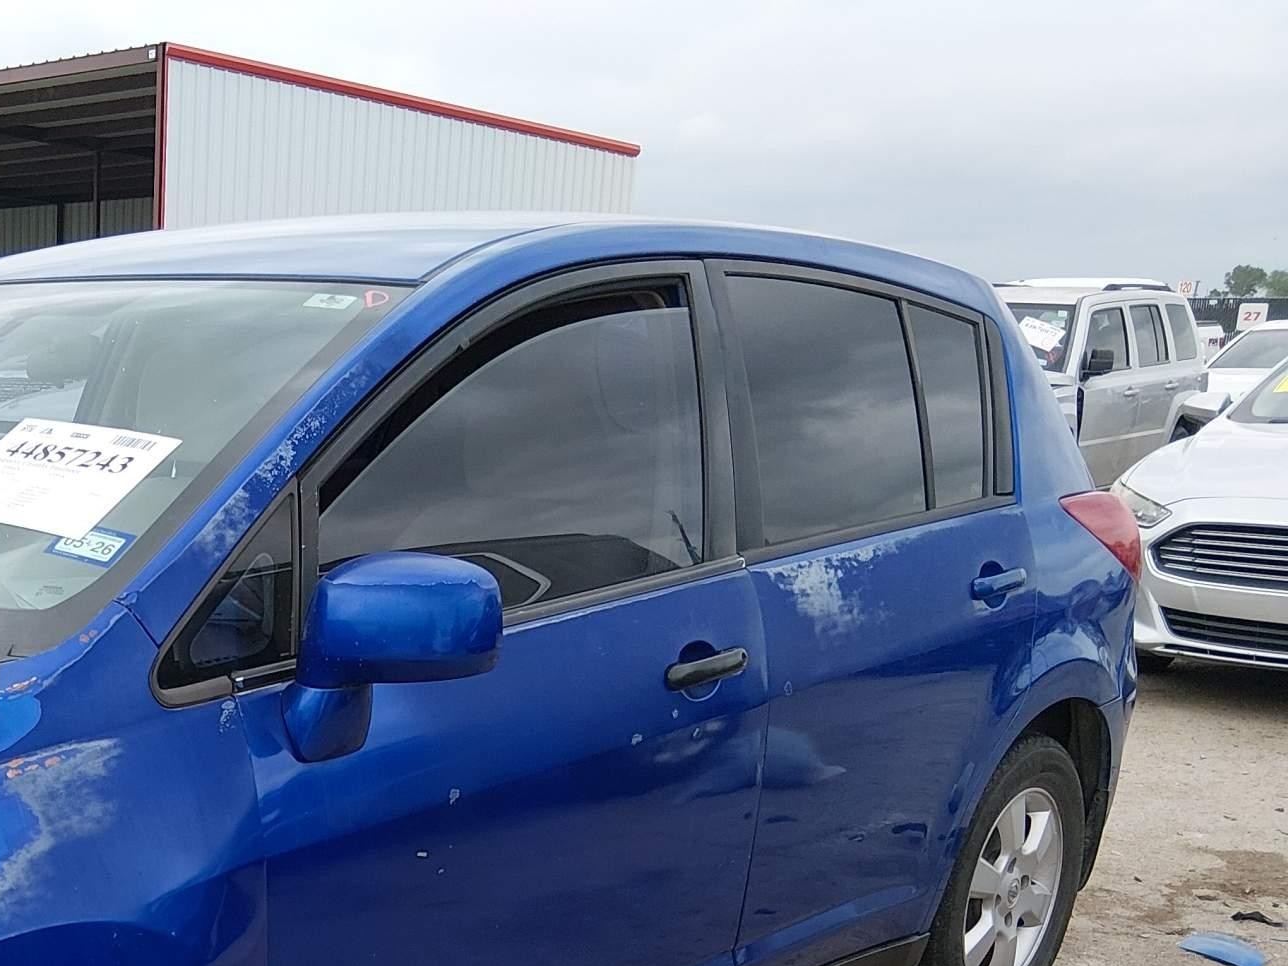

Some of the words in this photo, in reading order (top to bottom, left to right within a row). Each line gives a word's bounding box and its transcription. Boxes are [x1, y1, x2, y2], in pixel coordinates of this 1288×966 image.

[1179, 282, 1192, 293] 120
[1243, 311, 1261, 321] 27
[6, 441, 135, 474] 44857243
[90, 541, 116, 556] 26
